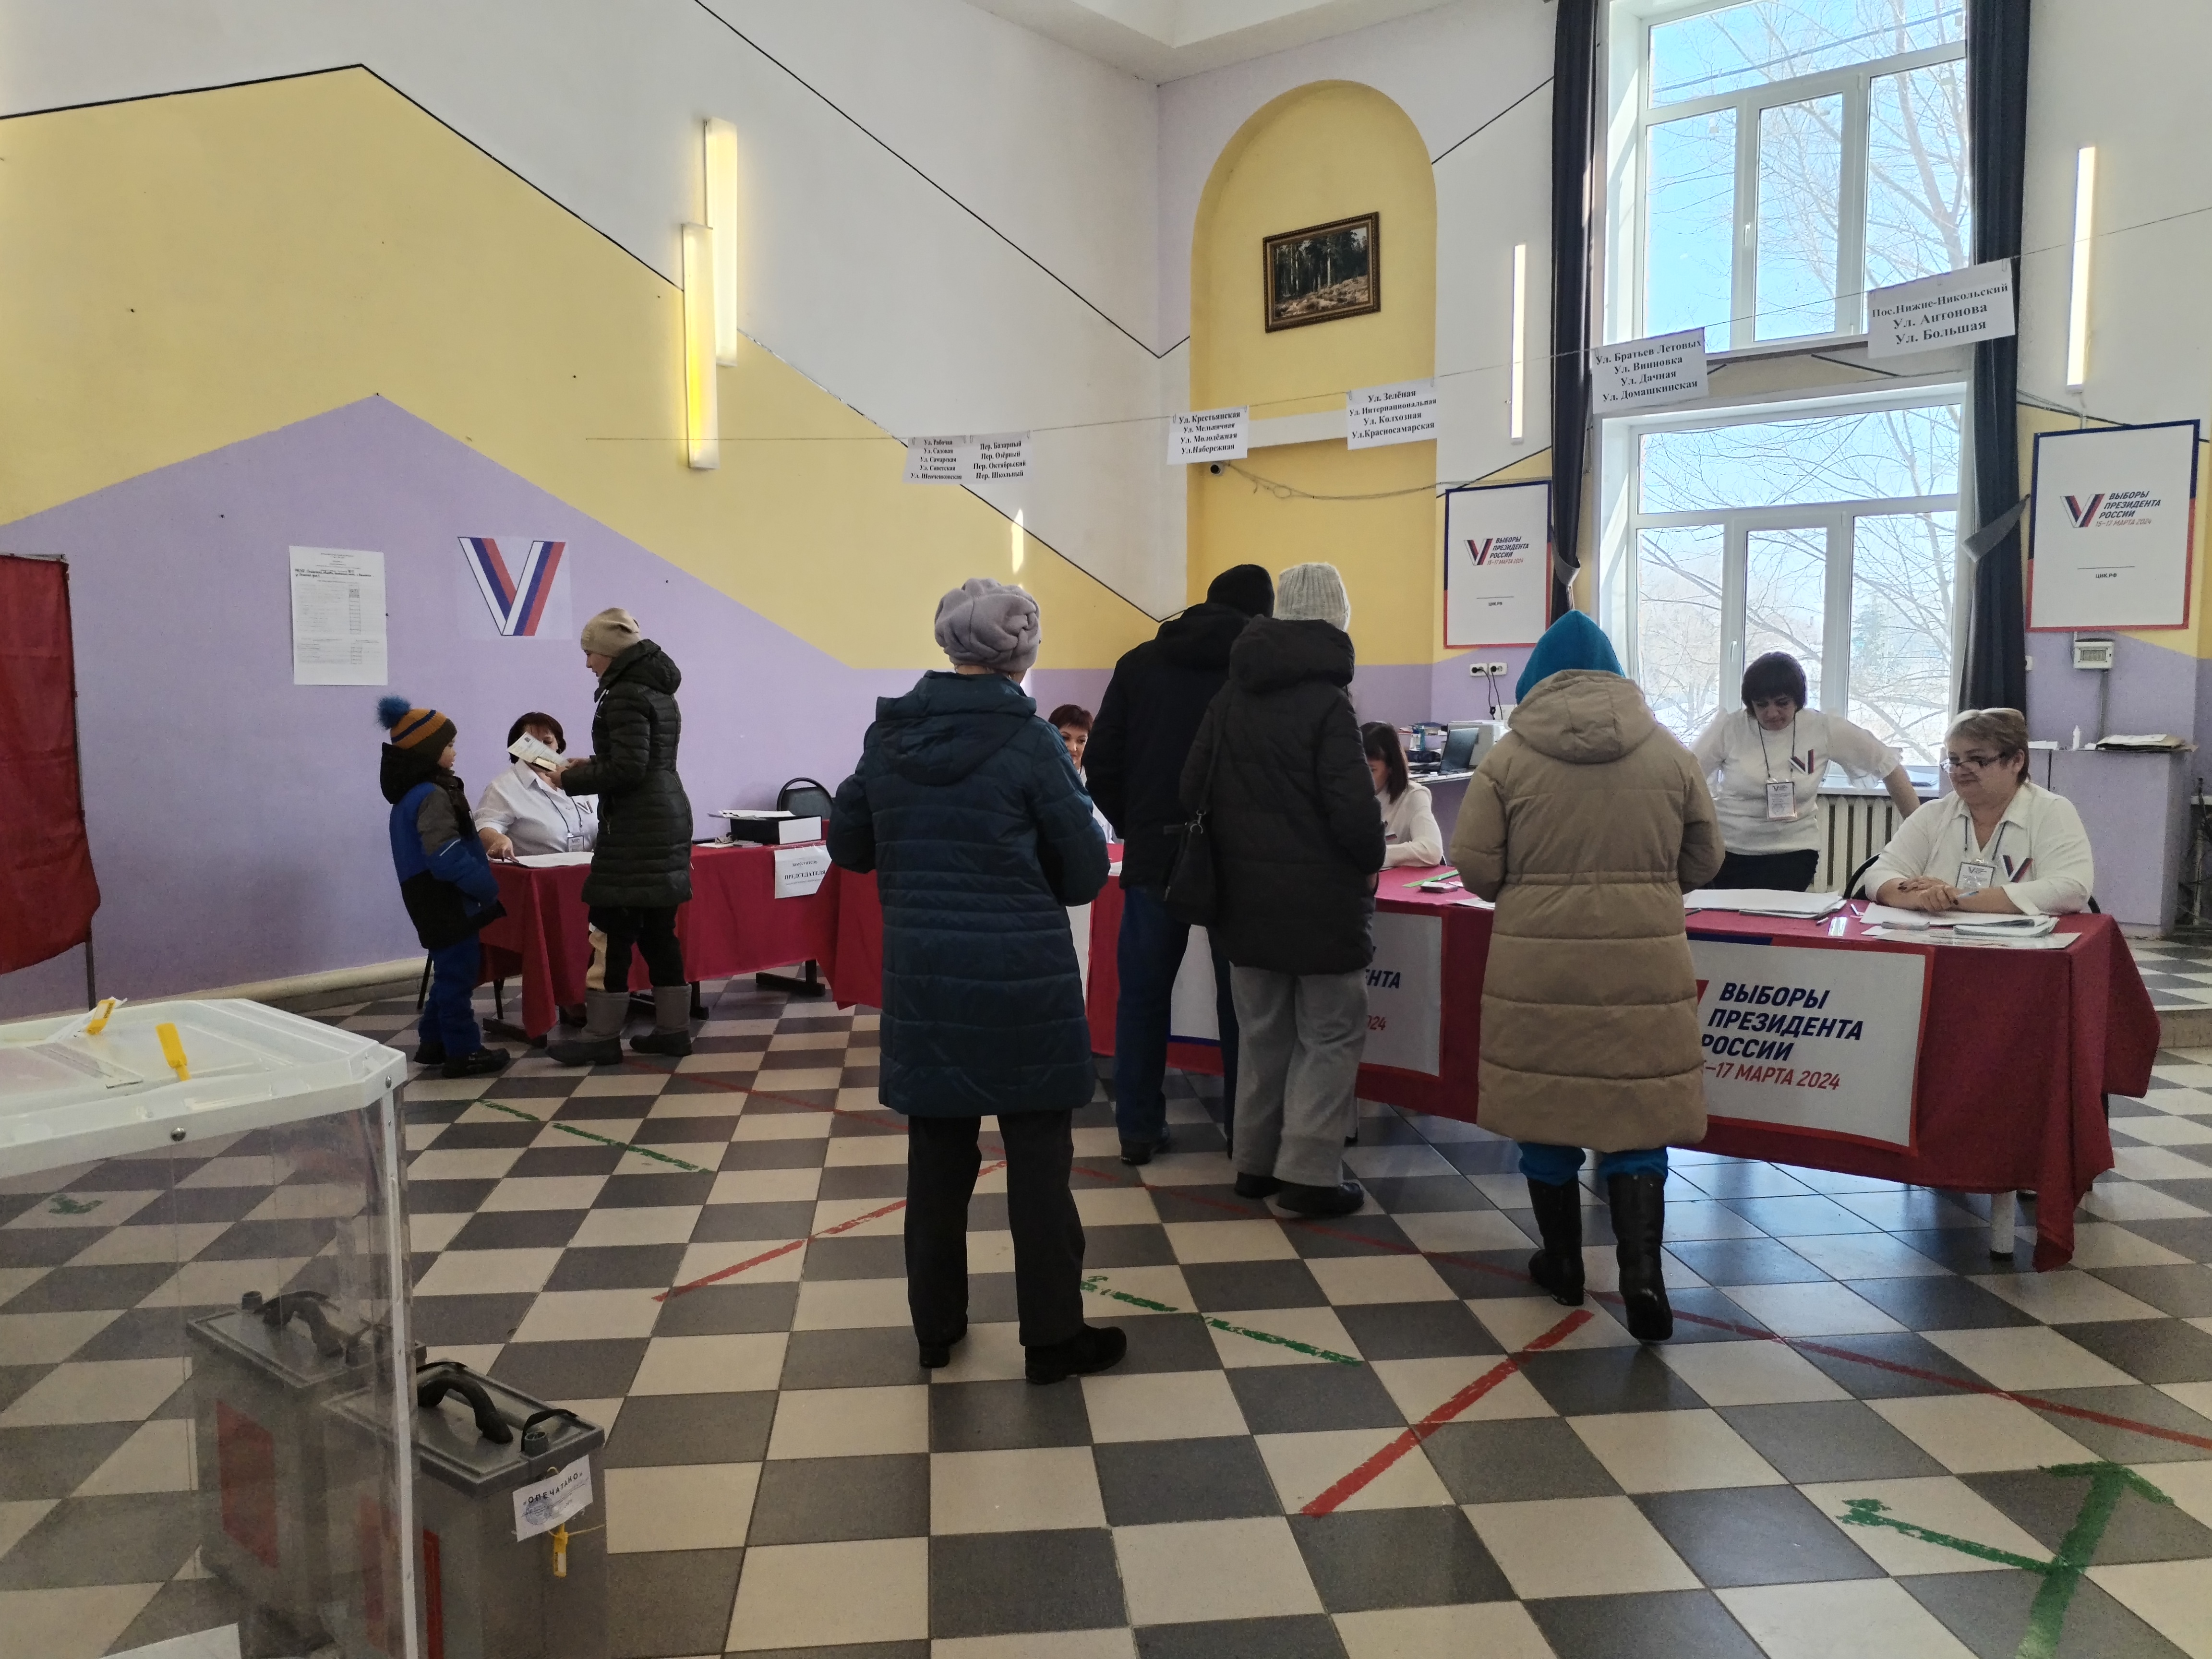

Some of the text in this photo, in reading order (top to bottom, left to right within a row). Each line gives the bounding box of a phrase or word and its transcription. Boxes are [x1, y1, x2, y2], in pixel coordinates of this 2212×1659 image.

[1872, 283, 2008, 318] Пос.Нижне-Никольский
[1893, 304, 1988, 330] Ул. Антонова
[1896, 321, 1986, 345] Ул. Большая
[1596, 340, 1701, 365] Ул. Братьев Летовых
[1614, 357, 1683, 374] Ул. Винновка
[1621, 371, 1676, 386] Ул. Дачная
[1383, 390, 1416, 400] Зелёная
[1602, 381, 1697, 402] Ул. Домашкинская
[1362, 398, 1436, 415] Интернациональная
[1192, 412, 1240, 424] Крестьянская
[1364, 412, 1421, 426] Ул. Колхозная
[1196, 423, 1235, 432] Мельничная
[1194, 433, 1237, 443] Молодёжная
[980, 440, 1021, 451] Пер. Базарный
[989, 460, 1025, 469] Октябрьский
[992, 470, 1023, 478] Школьный
[2109, 491, 2150, 500] ВЫБОРЫ
[2104, 499, 2161, 509] ПРЕЗИДЕНТА
[2099, 510, 2135, 519] РОССИИ
[1719, 982, 1830, 1010] ВЫБОРЫ
[1707, 1008, 1863, 1040] ПРЕЗИДЕНТА
[1734, 1064, 1794, 1085] МАРТА
[1796, 1070, 1840, 1090] 2024
